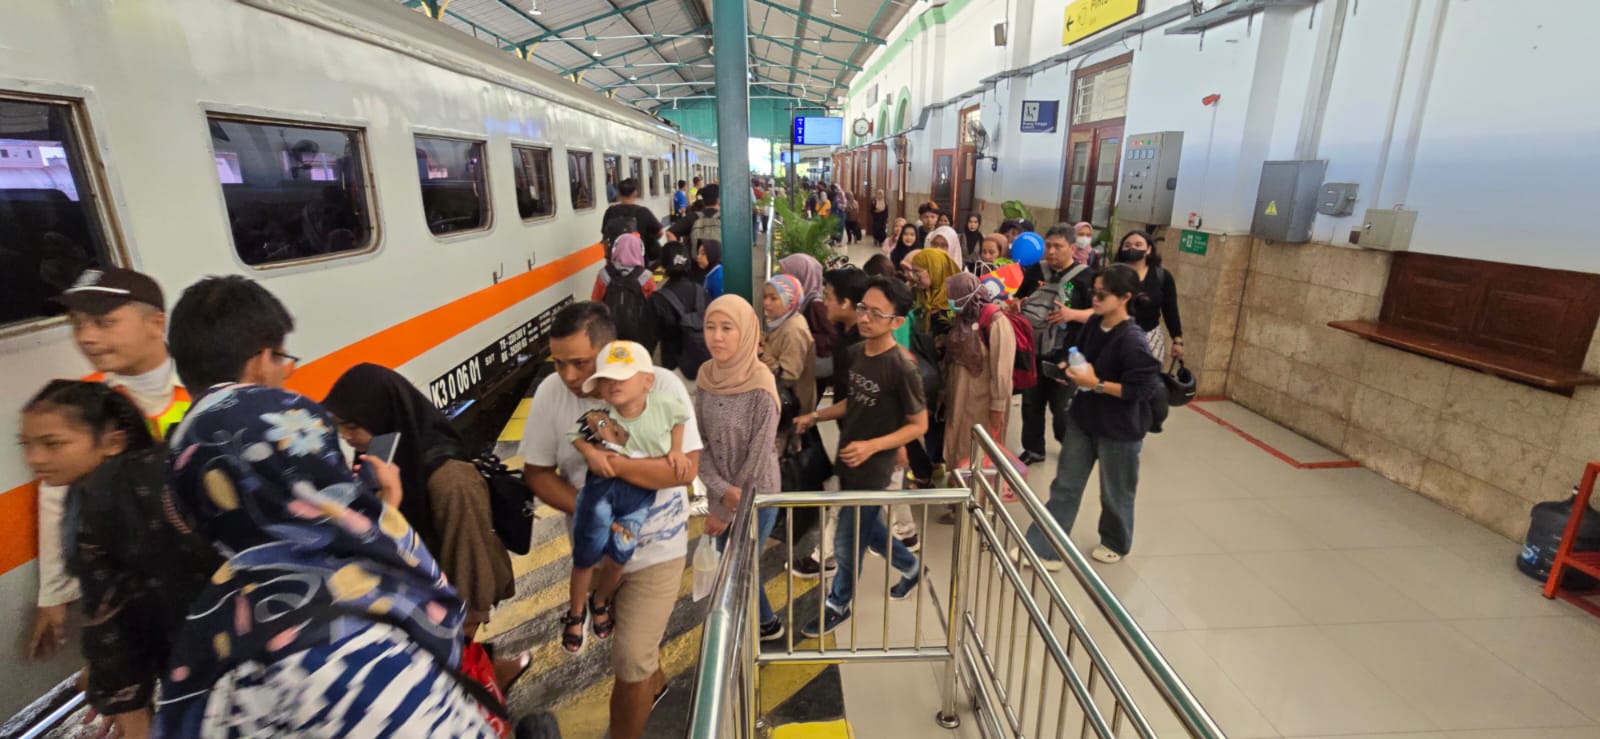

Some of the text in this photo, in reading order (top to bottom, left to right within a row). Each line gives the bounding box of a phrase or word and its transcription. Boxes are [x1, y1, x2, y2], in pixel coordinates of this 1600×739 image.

[431, 378, 449, 410] K3
[456, 363, 470, 394] 06
[469, 355, 482, 385] 01
